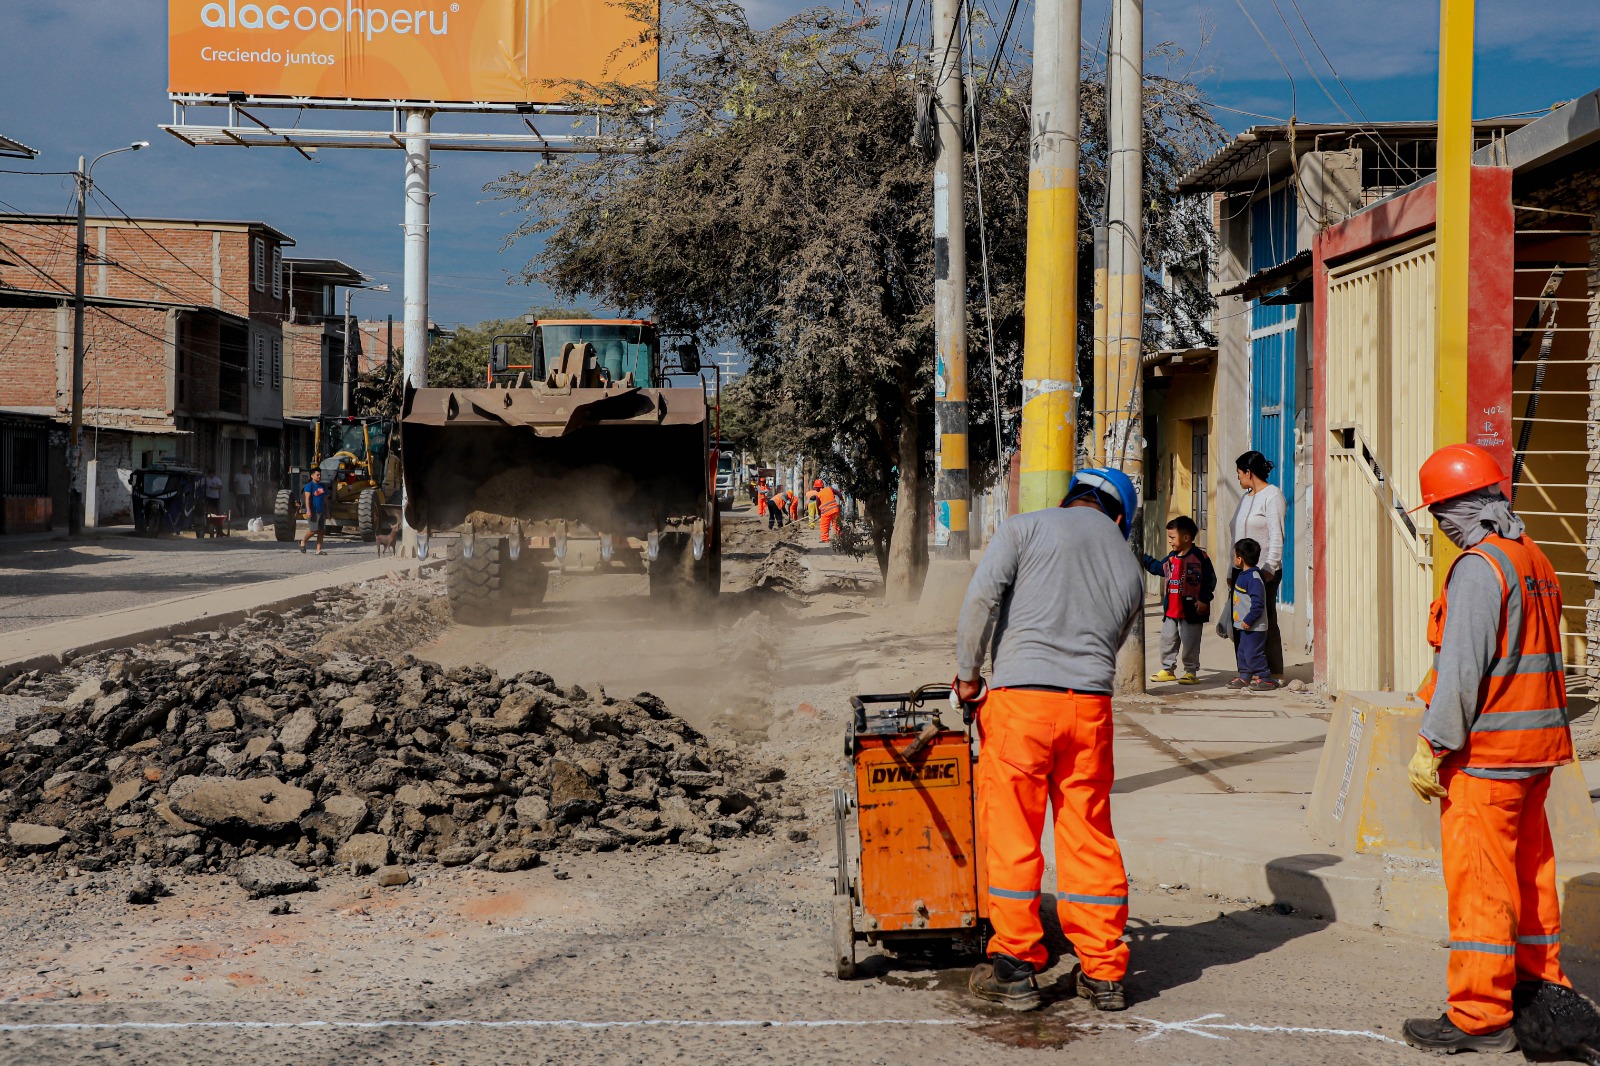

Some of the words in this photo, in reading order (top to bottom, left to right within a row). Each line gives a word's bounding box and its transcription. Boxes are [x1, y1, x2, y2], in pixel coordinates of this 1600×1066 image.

[201, 47, 281, 63] Creciendo
[284, 50, 335, 67] juntos
[1483, 405, 1505, 416] 402
